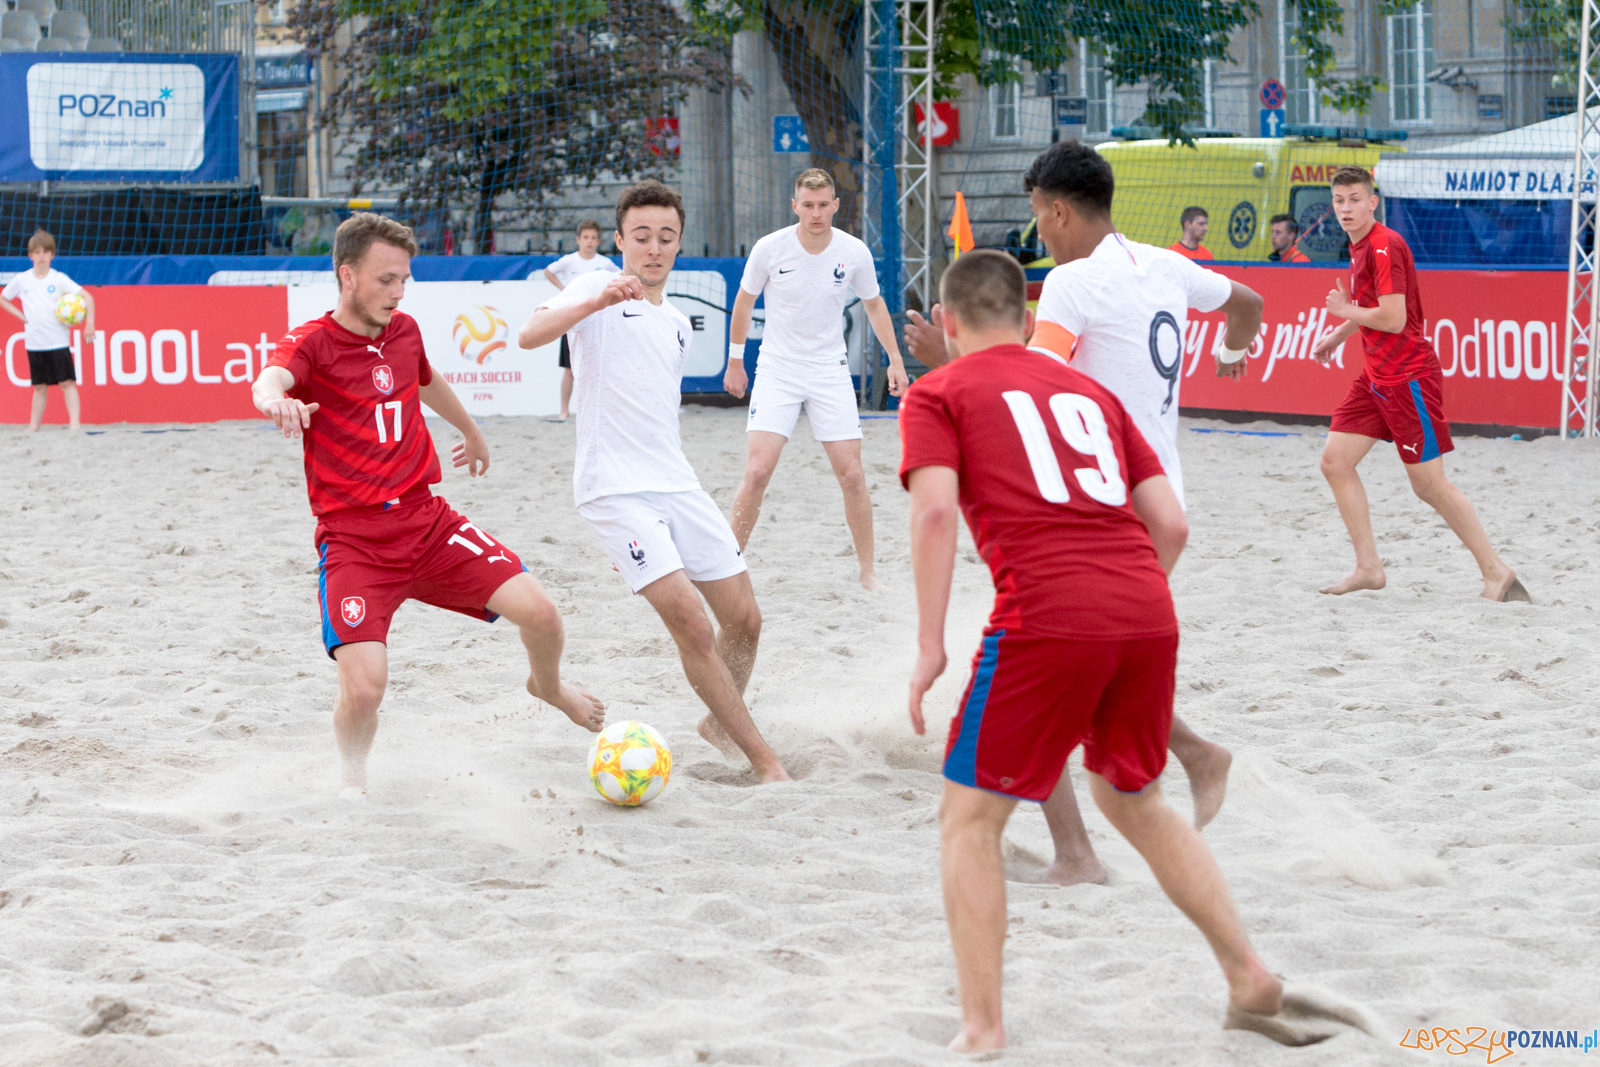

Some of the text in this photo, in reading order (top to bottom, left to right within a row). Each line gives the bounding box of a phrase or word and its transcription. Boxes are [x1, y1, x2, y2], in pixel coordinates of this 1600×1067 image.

[1445, 171, 1520, 192] NAMIOT
[1526, 172, 1562, 193] DLA
[480, 371, 522, 383] SOCCER
[1149, 310, 1181, 416] 9
[473, 392, 493, 401] PZPN
[375, 400, 402, 443] 17
[1002, 390, 1127, 507] 19
[447, 522, 496, 556] 17
